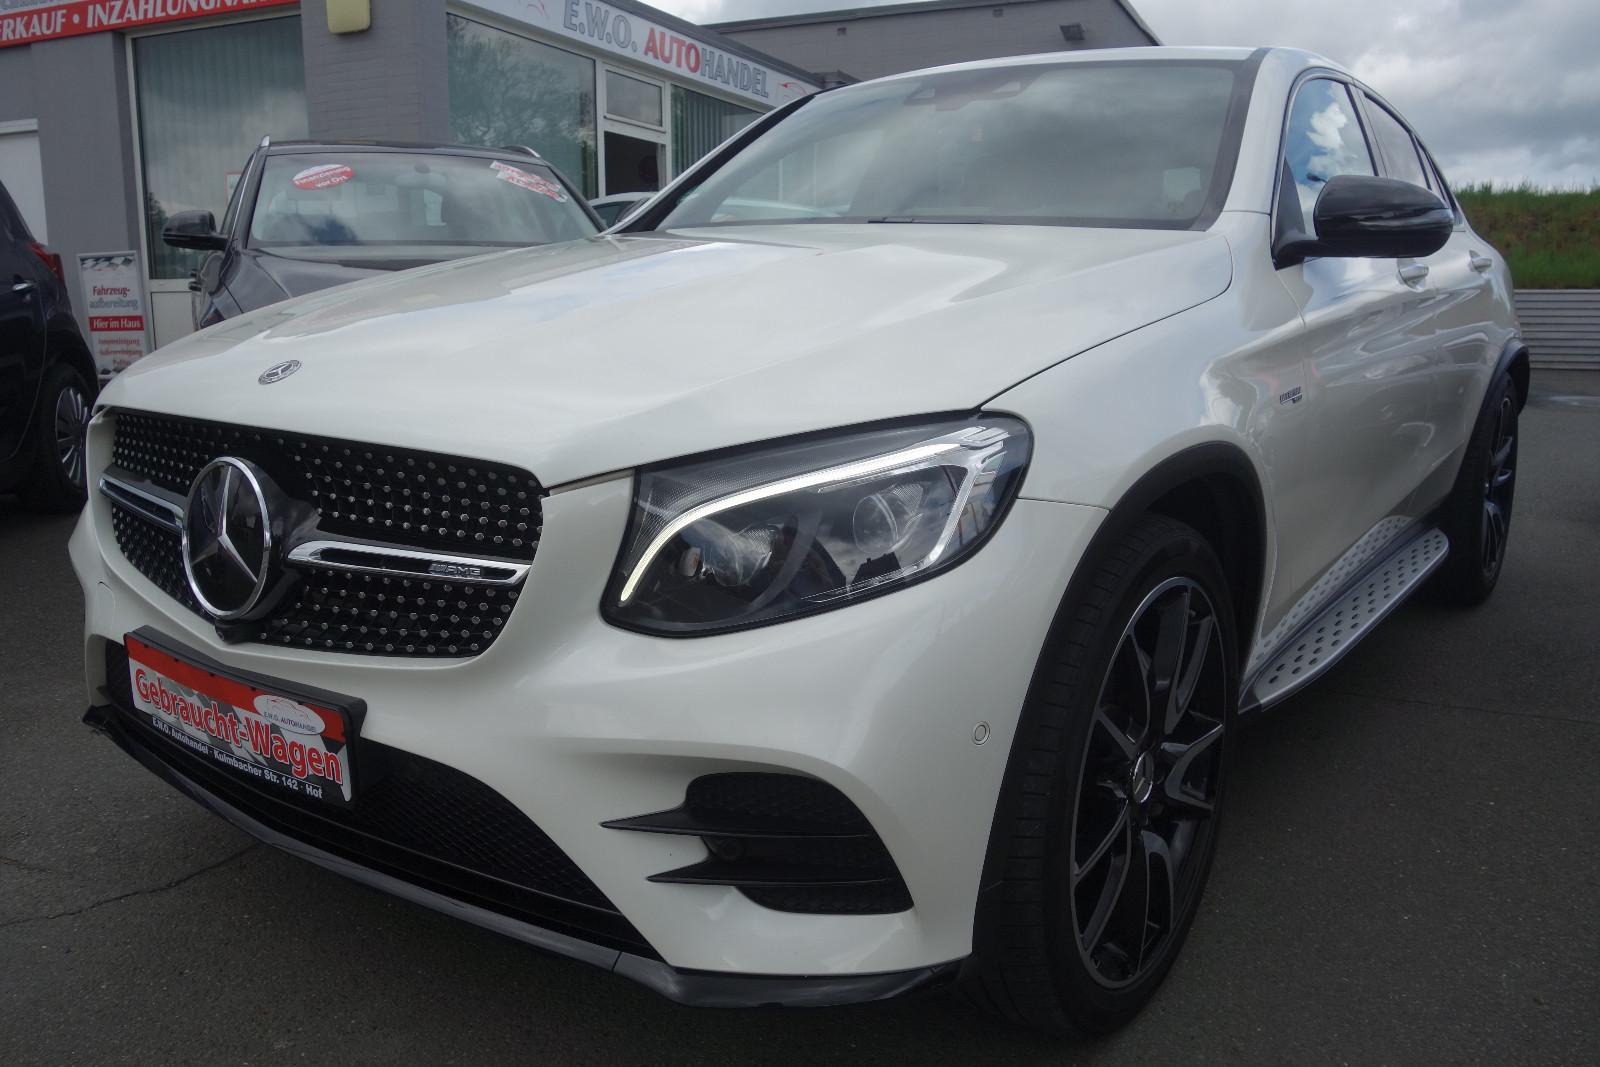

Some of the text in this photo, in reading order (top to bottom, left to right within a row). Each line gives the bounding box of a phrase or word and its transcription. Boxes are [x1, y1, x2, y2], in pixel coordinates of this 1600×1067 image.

[0, 9, 67, 41] RKAUF
[562, 0, 770, 99] E.W.O. AUTOHANDEL
[92, 284, 131, 298] Fahrzeug-
[93, 317, 142, 329] Hier im Haus
[447, 564, 482, 576] AMG
[134, 667, 344, 785] Gebraucht-Wagen
[171, 728, 209, 756] Autohandel
[213, 749, 262, 777] Kulmbacher
[263, 769, 280, 784] Str.
[281, 776, 299, 791] 142
